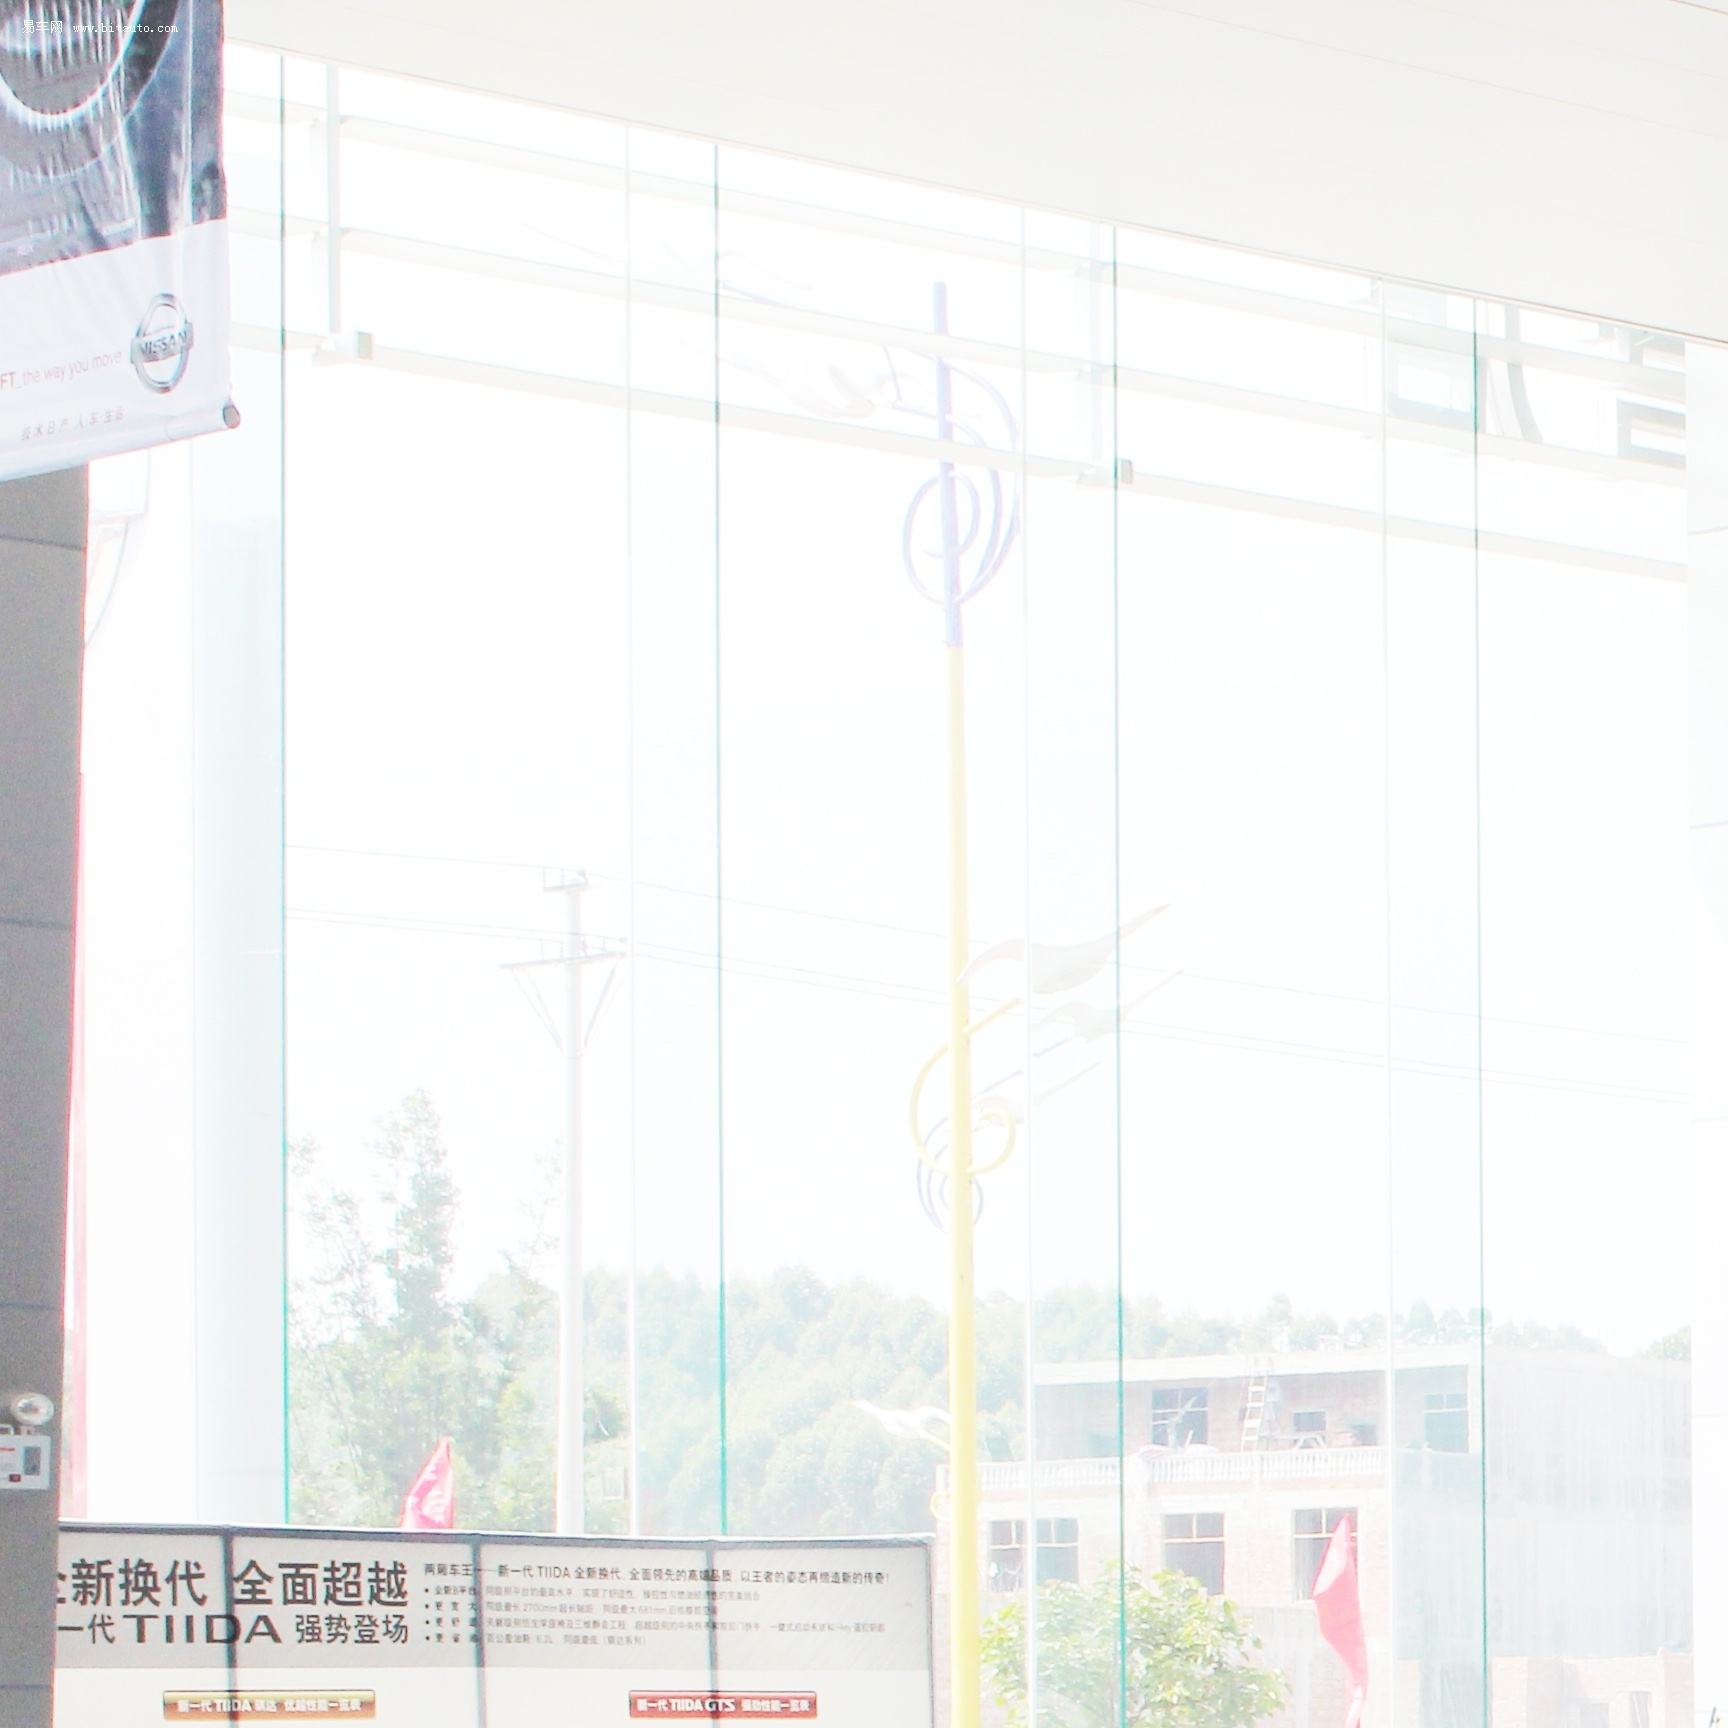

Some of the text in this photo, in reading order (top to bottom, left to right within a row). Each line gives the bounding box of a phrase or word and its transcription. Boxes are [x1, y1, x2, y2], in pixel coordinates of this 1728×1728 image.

[140, 330, 188, 357] NISSAN
[69, 360, 89, 382] you
[55, 1557, 410, 1609] 新换代 全面超越
[122, 1613, 283, 1645] TIIDA
[295, 1614, 409, 1646] 强势登场
